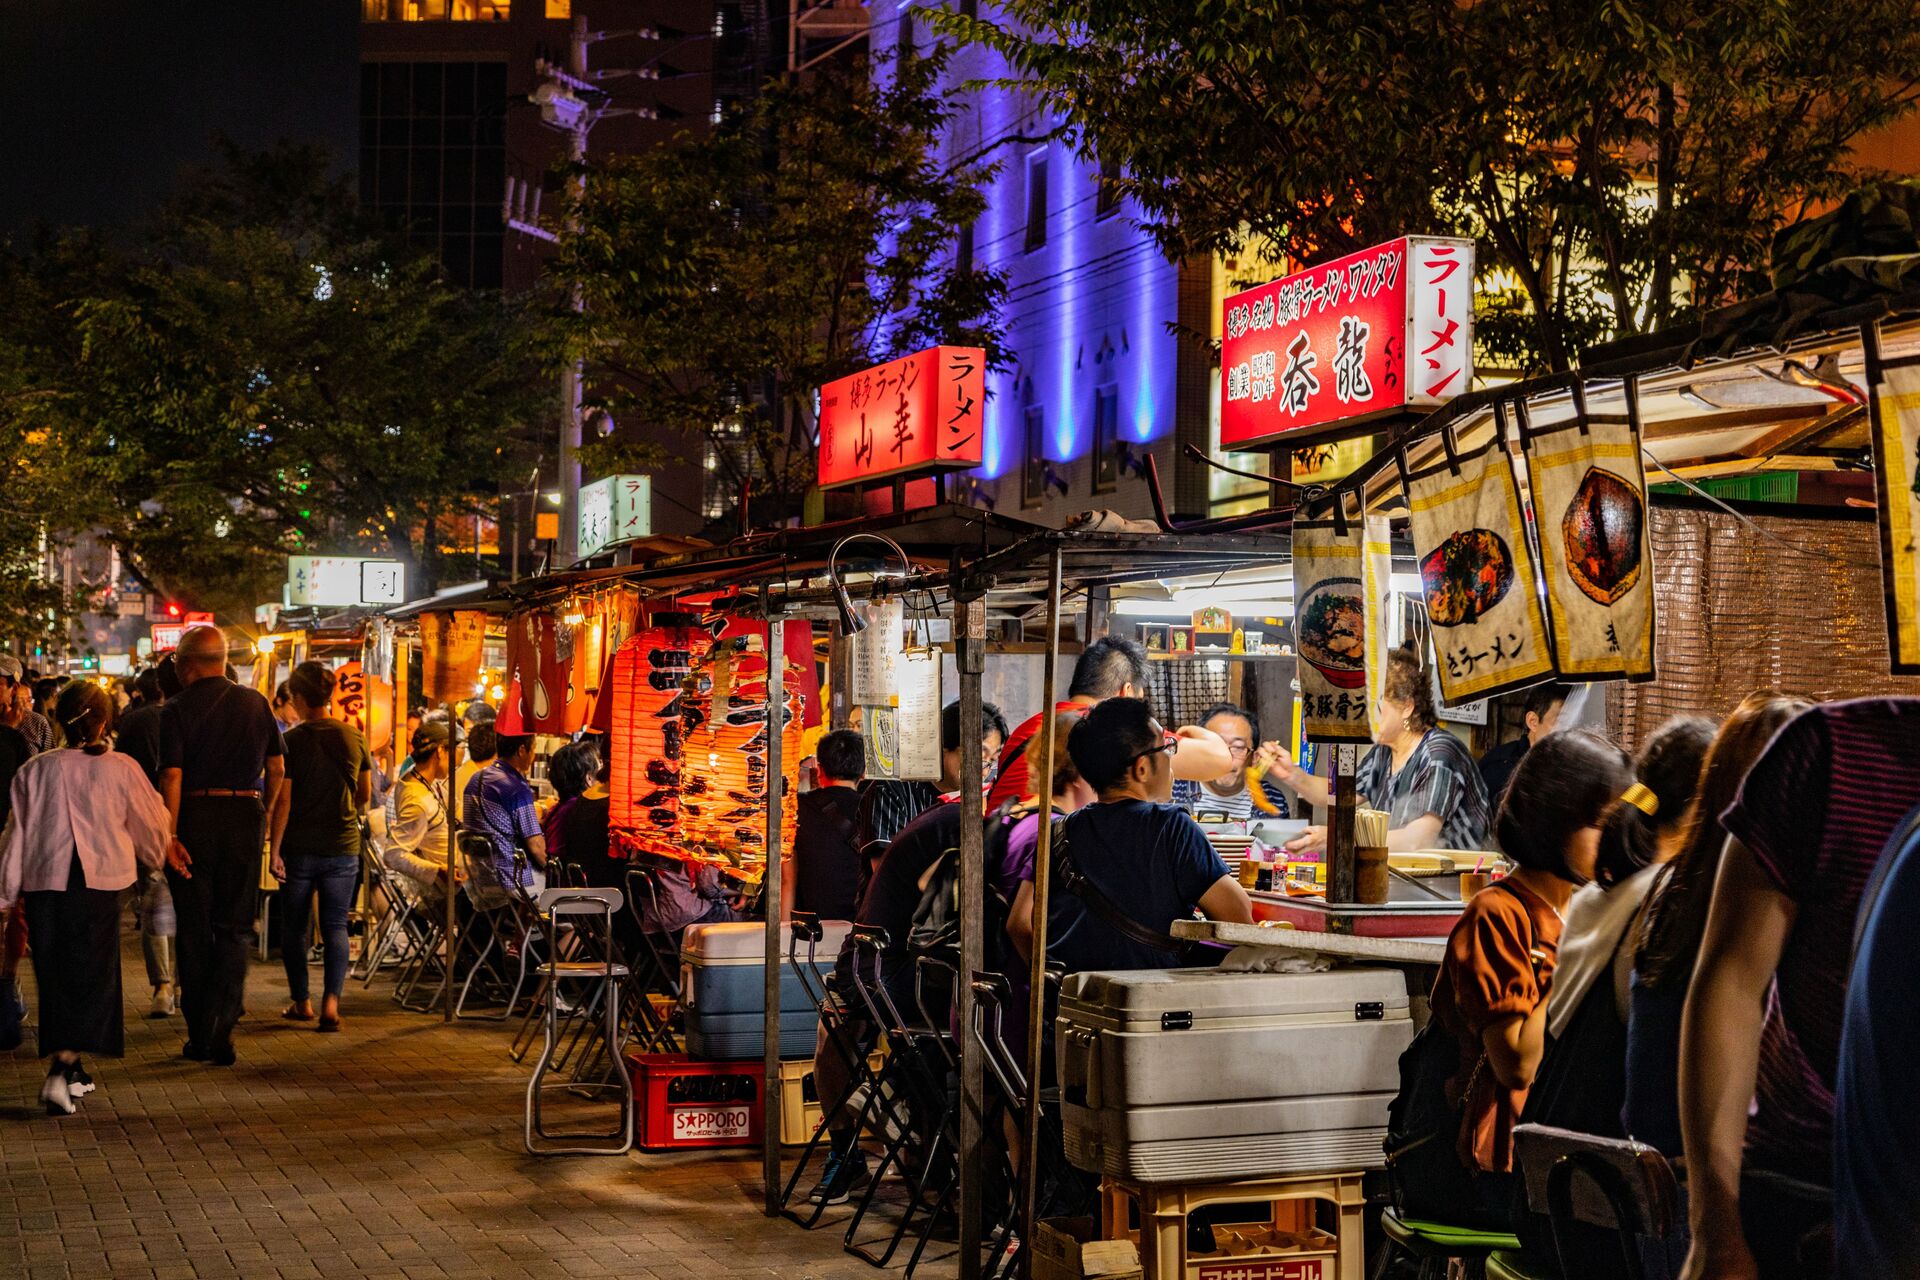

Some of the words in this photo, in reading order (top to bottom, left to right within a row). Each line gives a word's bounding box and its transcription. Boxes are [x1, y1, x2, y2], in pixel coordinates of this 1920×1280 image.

[1420, 247, 1461, 398] ラーメン
[850, 360, 921, 410] 博多ラーメン
[1228, 364, 1250, 400] 創業
[1252, 378, 1275, 401] 20年
[1280, 318, 1373, 413] 呑龍
[947, 355, 976, 452] ラーメン
